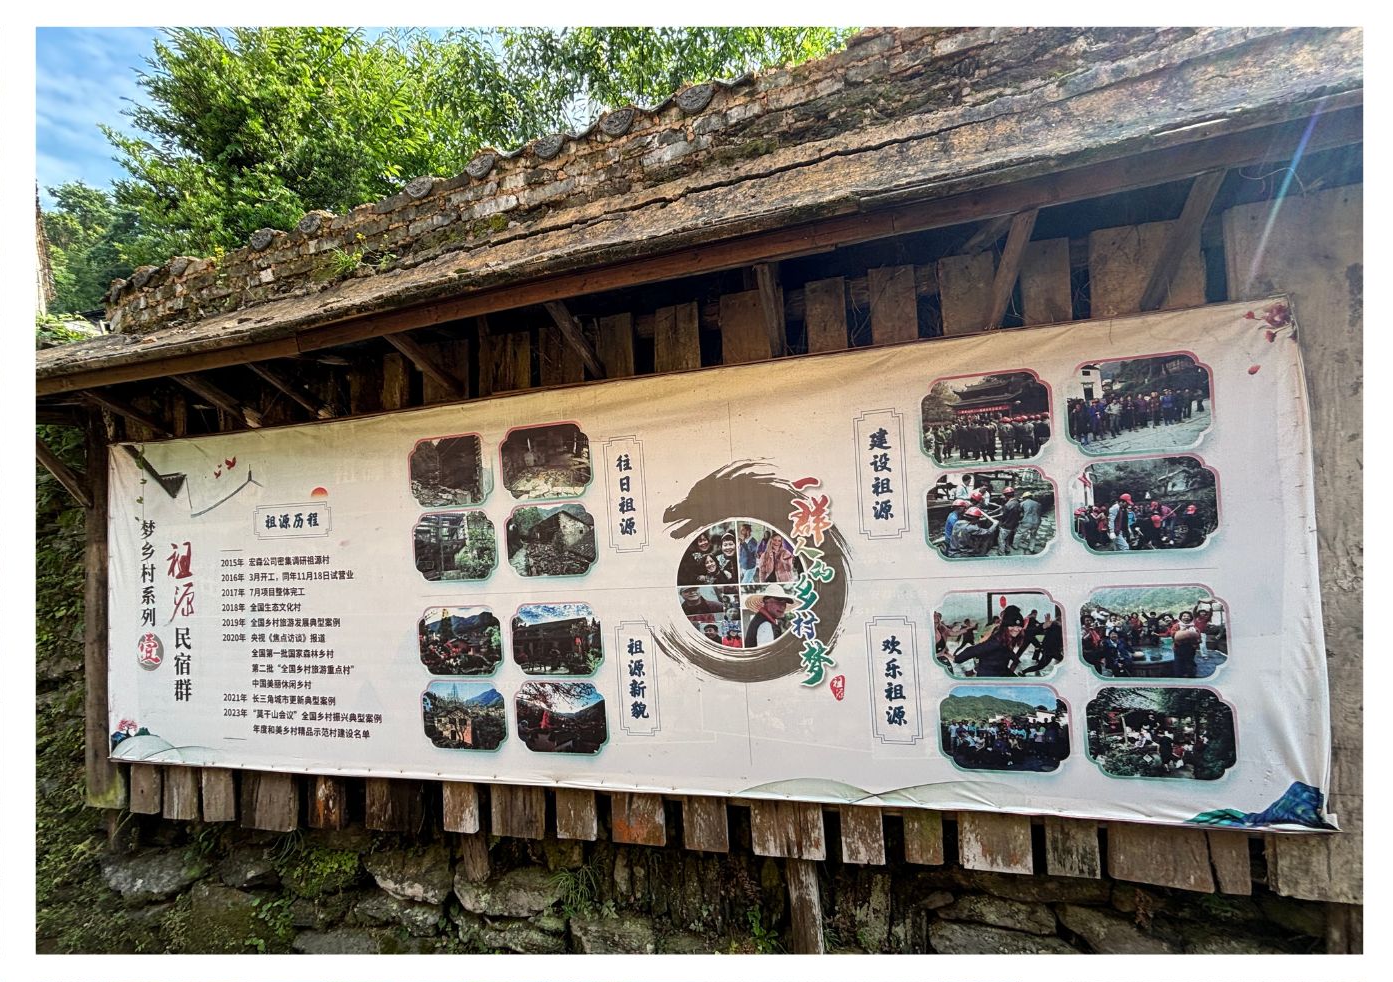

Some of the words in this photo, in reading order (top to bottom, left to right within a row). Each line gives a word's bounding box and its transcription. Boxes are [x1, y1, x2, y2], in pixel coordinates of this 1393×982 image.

[868, 426, 894, 521] 建设祖源
[614, 453, 637, 537] 往日祖源
[265, 512, 320, 529] 祖源历程
[220, 558, 245, 567] 2015年
[140, 520, 156, 627] 梦乡村系列
[221, 573, 245, 582] 2016年
[221, 588, 246, 597] 2017年
[249, 587, 306, 597] 7月项目整体完工
[221, 603, 246, 612] 2018年
[250, 602, 302, 613] 全国生态文化村
[222, 618, 246, 627] 2019年
[250, 617, 341, 628] 全国乡村旅游发展典型案例
[222, 633, 247, 642] 2020年
[251, 648, 334, 659] 全国第一批国家森林乡村
[626, 636, 650, 721] 祖源新貌
[881, 634, 908, 728] 欢乐祖源
[252, 679, 312, 690] 中国美丽休闲乡村
[223, 693, 248, 702] 2021年
[252, 693, 336, 707] 长三角城市更新典型案例
[223, 708, 248, 718] 2023年
[252, 724, 370, 739] 年度和美乡村精品示范村建设名单
